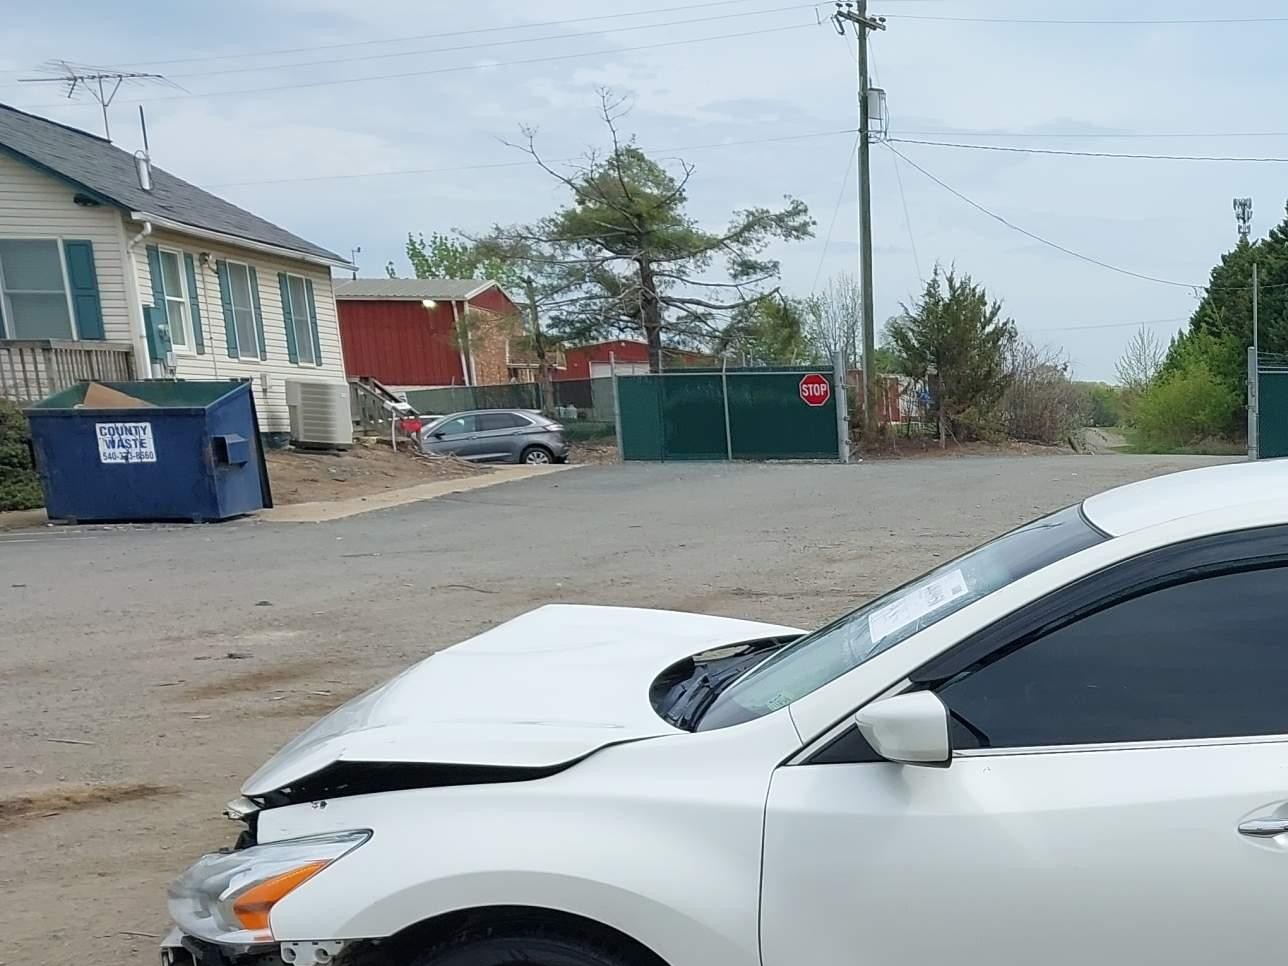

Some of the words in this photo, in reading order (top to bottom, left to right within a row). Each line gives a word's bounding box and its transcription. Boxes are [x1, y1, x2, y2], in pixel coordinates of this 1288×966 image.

[802, 383, 827, 396] STOP
[100, 425, 147, 436] COUNTY
[104, 439, 148, 449] WASTE
